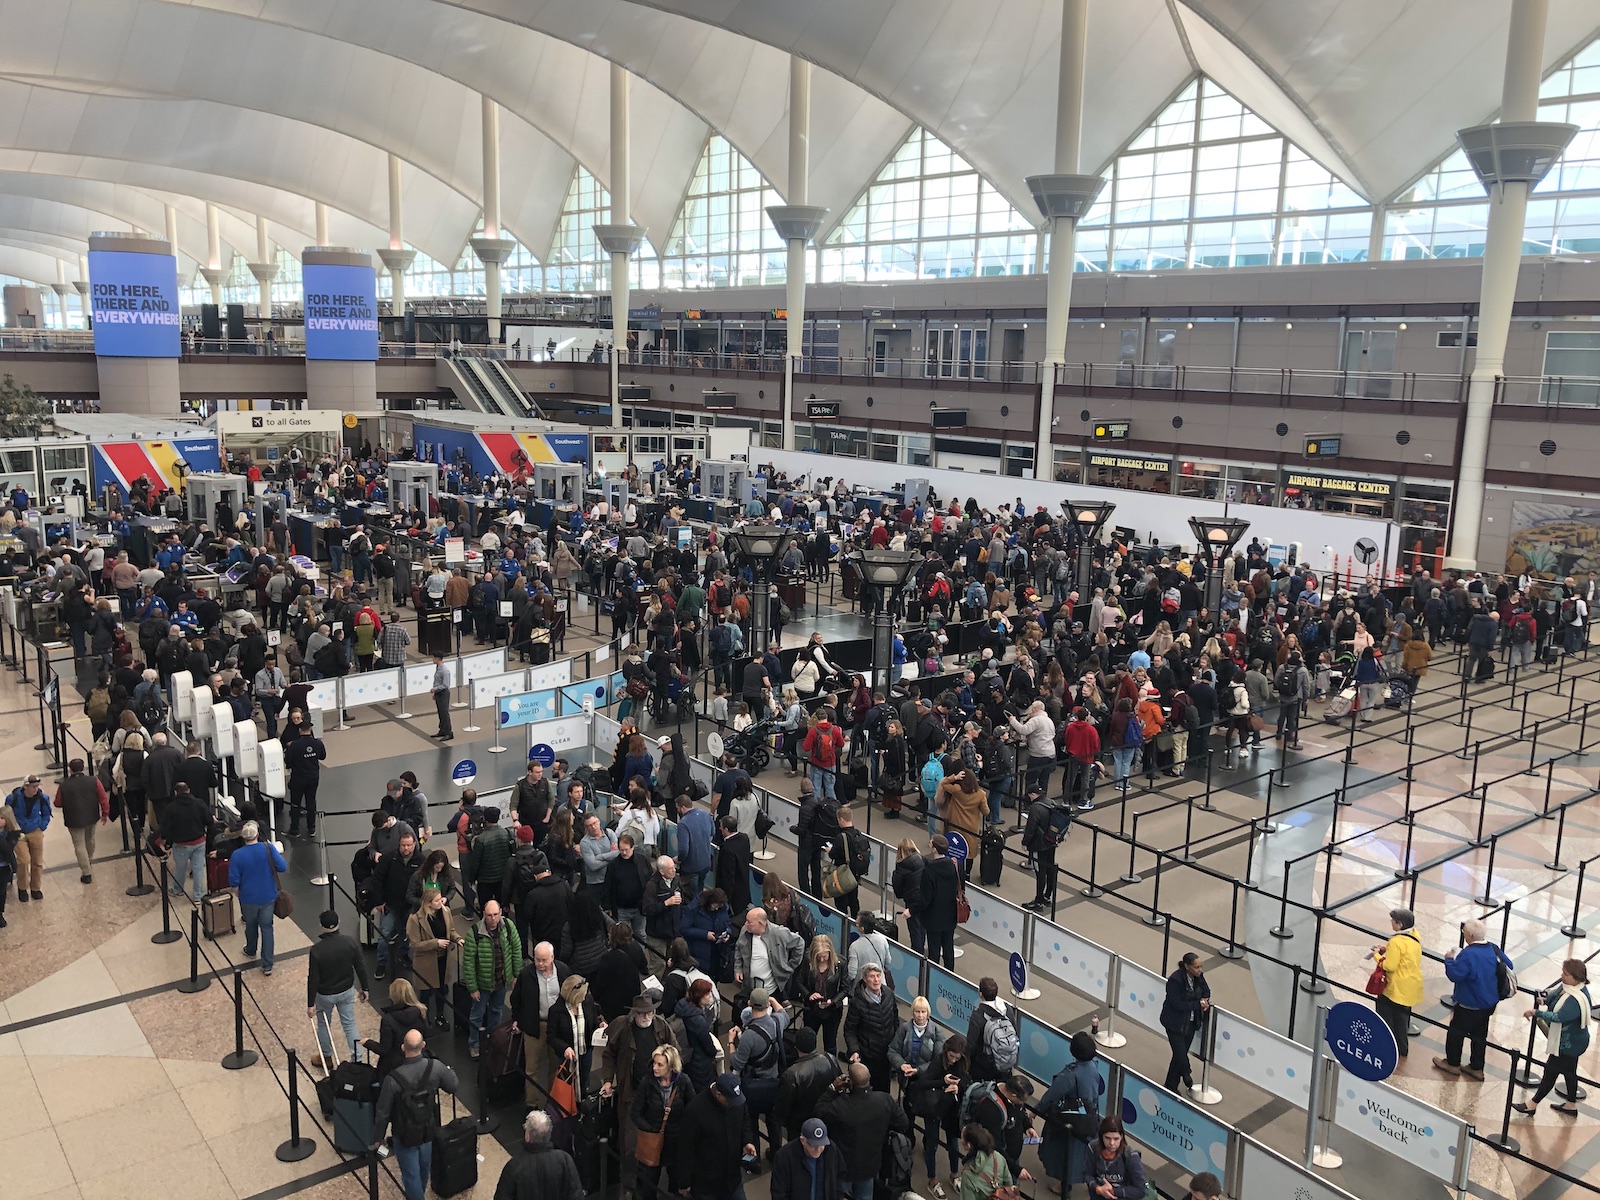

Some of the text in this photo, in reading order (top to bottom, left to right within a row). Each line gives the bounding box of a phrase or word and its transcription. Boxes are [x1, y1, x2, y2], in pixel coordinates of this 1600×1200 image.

[94, 284, 163, 299] FOR HERE,
[94, 298, 169, 312] THERE AND
[307, 294, 367, 308] FOR HERE,
[95, 310, 180, 326] EVERYWHERE
[308, 307, 372, 319] THERE AND
[811, 406, 821, 414] TSA
[266, 417, 312, 426] to all Gates
[830, 431, 838, 439] TSA
[184, 444, 211, 452] Southwest
[1091, 455, 1169, 472] AIRPORT BAGGAGE CENTER
[1288, 474, 1390, 495] AIRPORT BAGGAGE CENTER
[517, 702, 530, 710] You
[517, 710, 531, 718] your
[820, 919, 835, 935] best
[937, 983, 963, 1005] Speed
[946, 1003, 965, 1020] with
[1336, 1038, 1383, 1070] CLEAR
[1154, 1104, 1195, 1137] You are
[1366, 1098, 1425, 1137] Welcome
[1152, 1121, 1194, 1151] your ID
[1379, 1119, 1409, 1145] back
